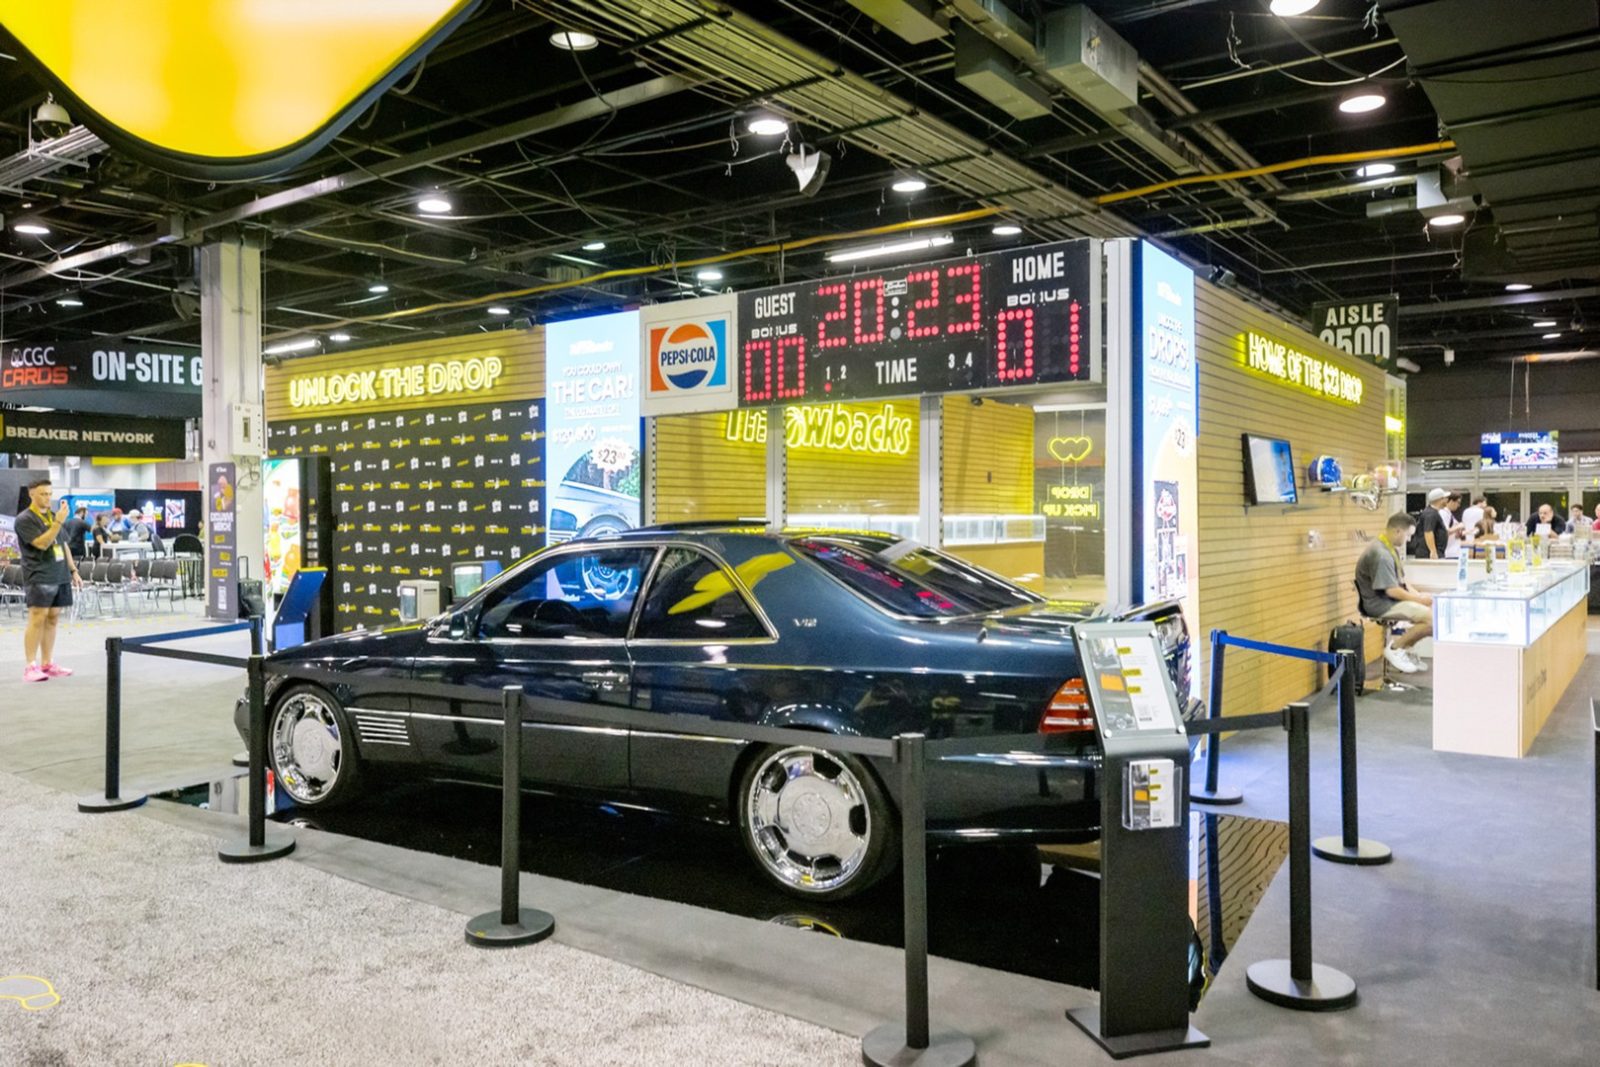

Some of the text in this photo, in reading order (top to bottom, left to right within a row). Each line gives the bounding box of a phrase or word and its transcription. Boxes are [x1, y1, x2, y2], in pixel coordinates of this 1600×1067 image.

[1012, 251, 1065, 284] HOME
[755, 292, 796, 319] GUEST
[1325, 303, 1384, 327] AISLE
[22, 346, 56, 367] CGC
[92, 350, 185, 385] ON-SITE
[744, 335, 805, 401] 00
[1249, 332, 1287, 379] HOME
[1287, 349, 1302, 384] OF
[1303, 357, 1323, 391] THE
[1340, 370, 1363, 404] DROP
[3, 367, 69, 388] CARDS
[289, 356, 502, 407] UNLOCK THE DROP
[875, 358, 917, 385] TIME
[552, 373, 634, 404] THE CAR!
[5, 426, 154, 444] BREAKER NETWORK
